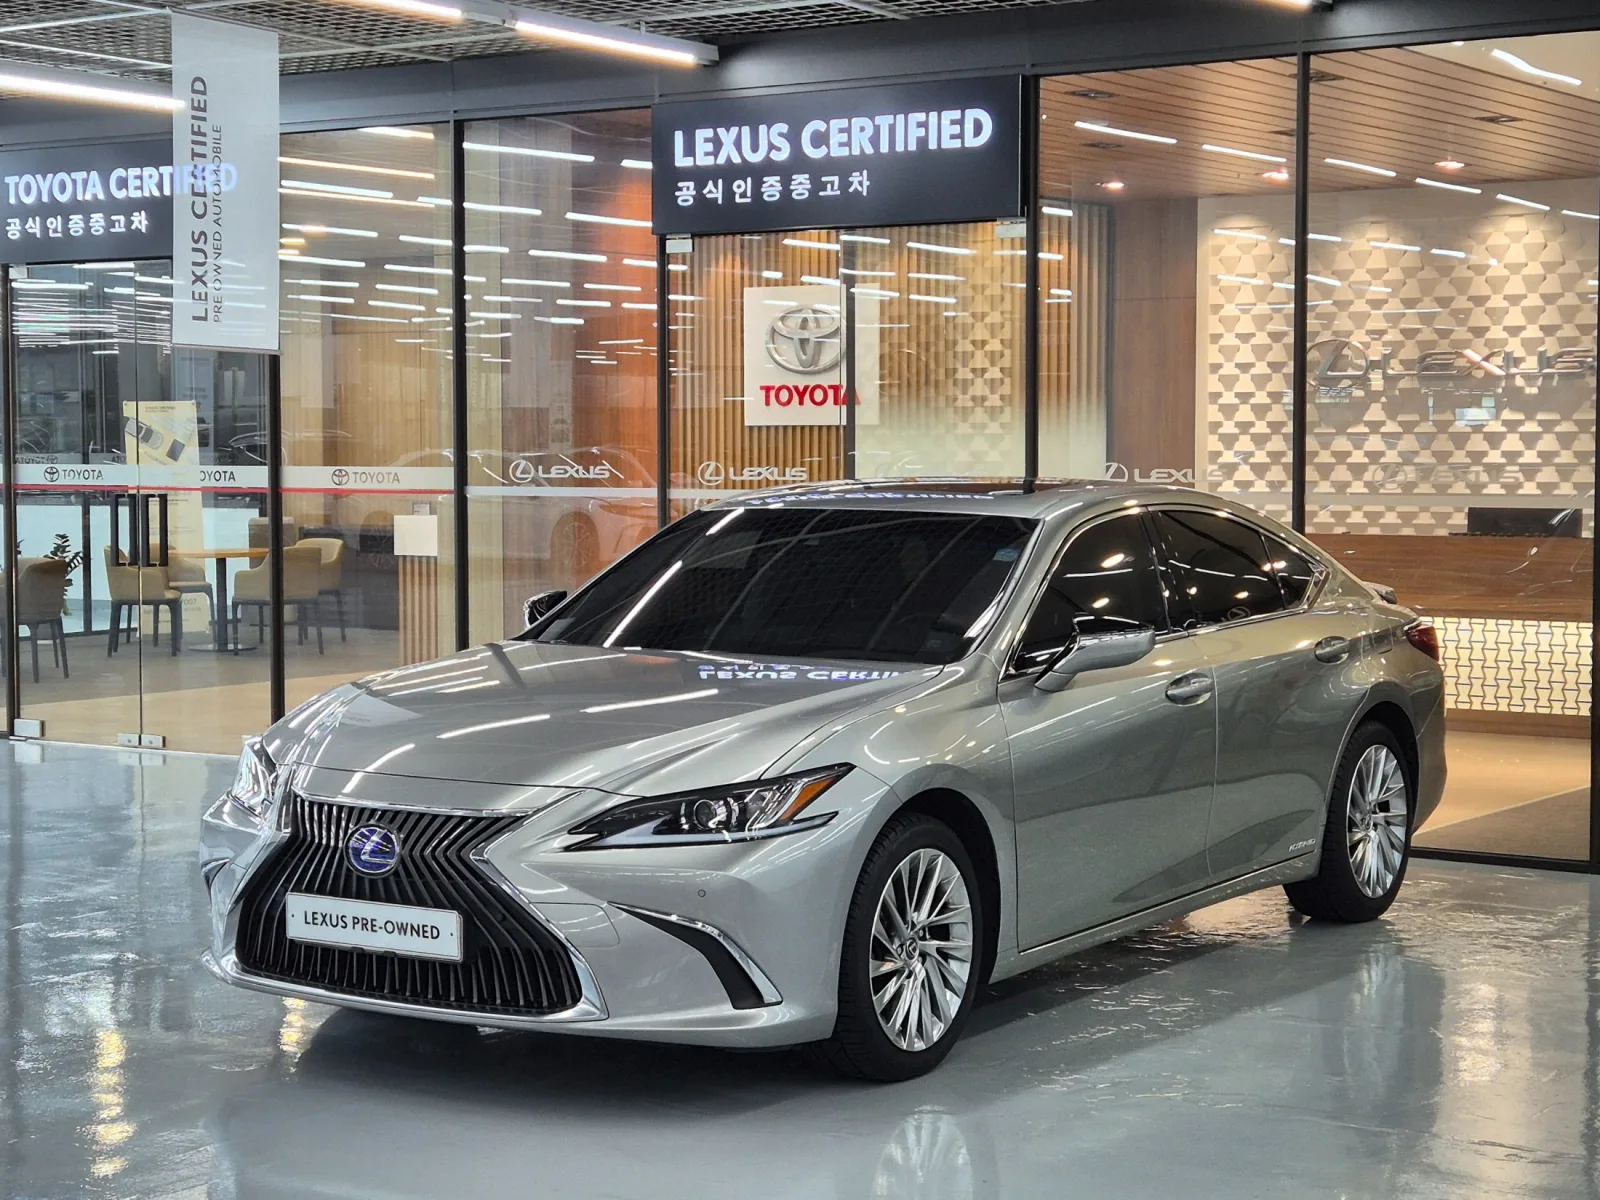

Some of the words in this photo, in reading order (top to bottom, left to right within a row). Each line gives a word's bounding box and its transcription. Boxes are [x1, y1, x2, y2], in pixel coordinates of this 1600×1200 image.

[674, 122, 791, 167] LEXUS
[801, 108, 993, 158] CERTIFIED
[4, 170, 104, 204] TOYOTA
[109, 162, 238, 199] CERTIFIED
[674, 169, 871, 206] 공식인증중고차
[5, 210, 149, 240] 공식인증중고차
[212, 231, 222, 292] OWNED
[191, 231, 208, 322] LEXUS
[213, 296, 222, 323] PRE
[1382, 347, 1595, 376] LEXUS
[62, 469, 104, 481] TOYOTA
[200, 471, 236, 482] OYOTA
[352, 471, 400, 484] TOYOTA
[538, 465, 611, 479] LEXUS
[729, 465, 808, 481] LEXUS
[303, 910, 348, 929] LEXUS
[352, 916, 440, 940] PRE-OWNED
